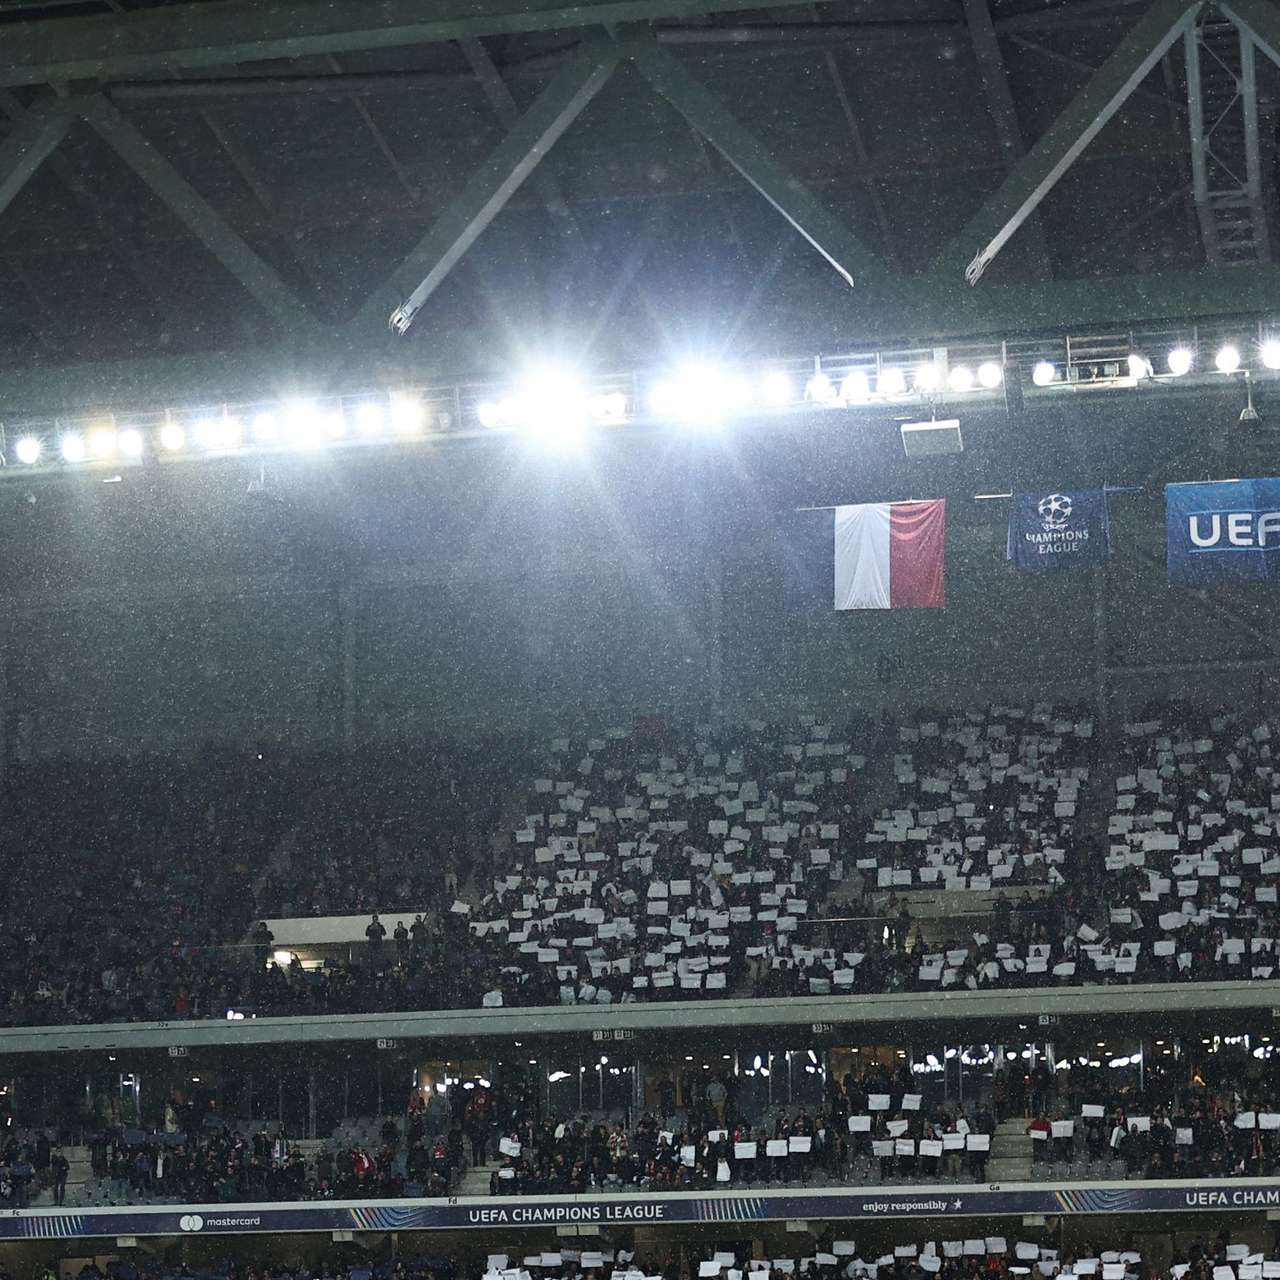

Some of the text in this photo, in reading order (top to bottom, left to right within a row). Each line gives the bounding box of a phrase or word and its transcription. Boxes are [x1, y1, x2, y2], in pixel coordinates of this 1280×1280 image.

[1039, 542, 1080, 554] EAGUE
[1186, 1192, 1228, 1206] UEFA
[862, 1200, 948, 1212] enjoy responsibly
[469, 1204, 664, 1222] UEFA CHAMPIONS LEAGUE
[206, 1216, 261, 1226] mastercard
